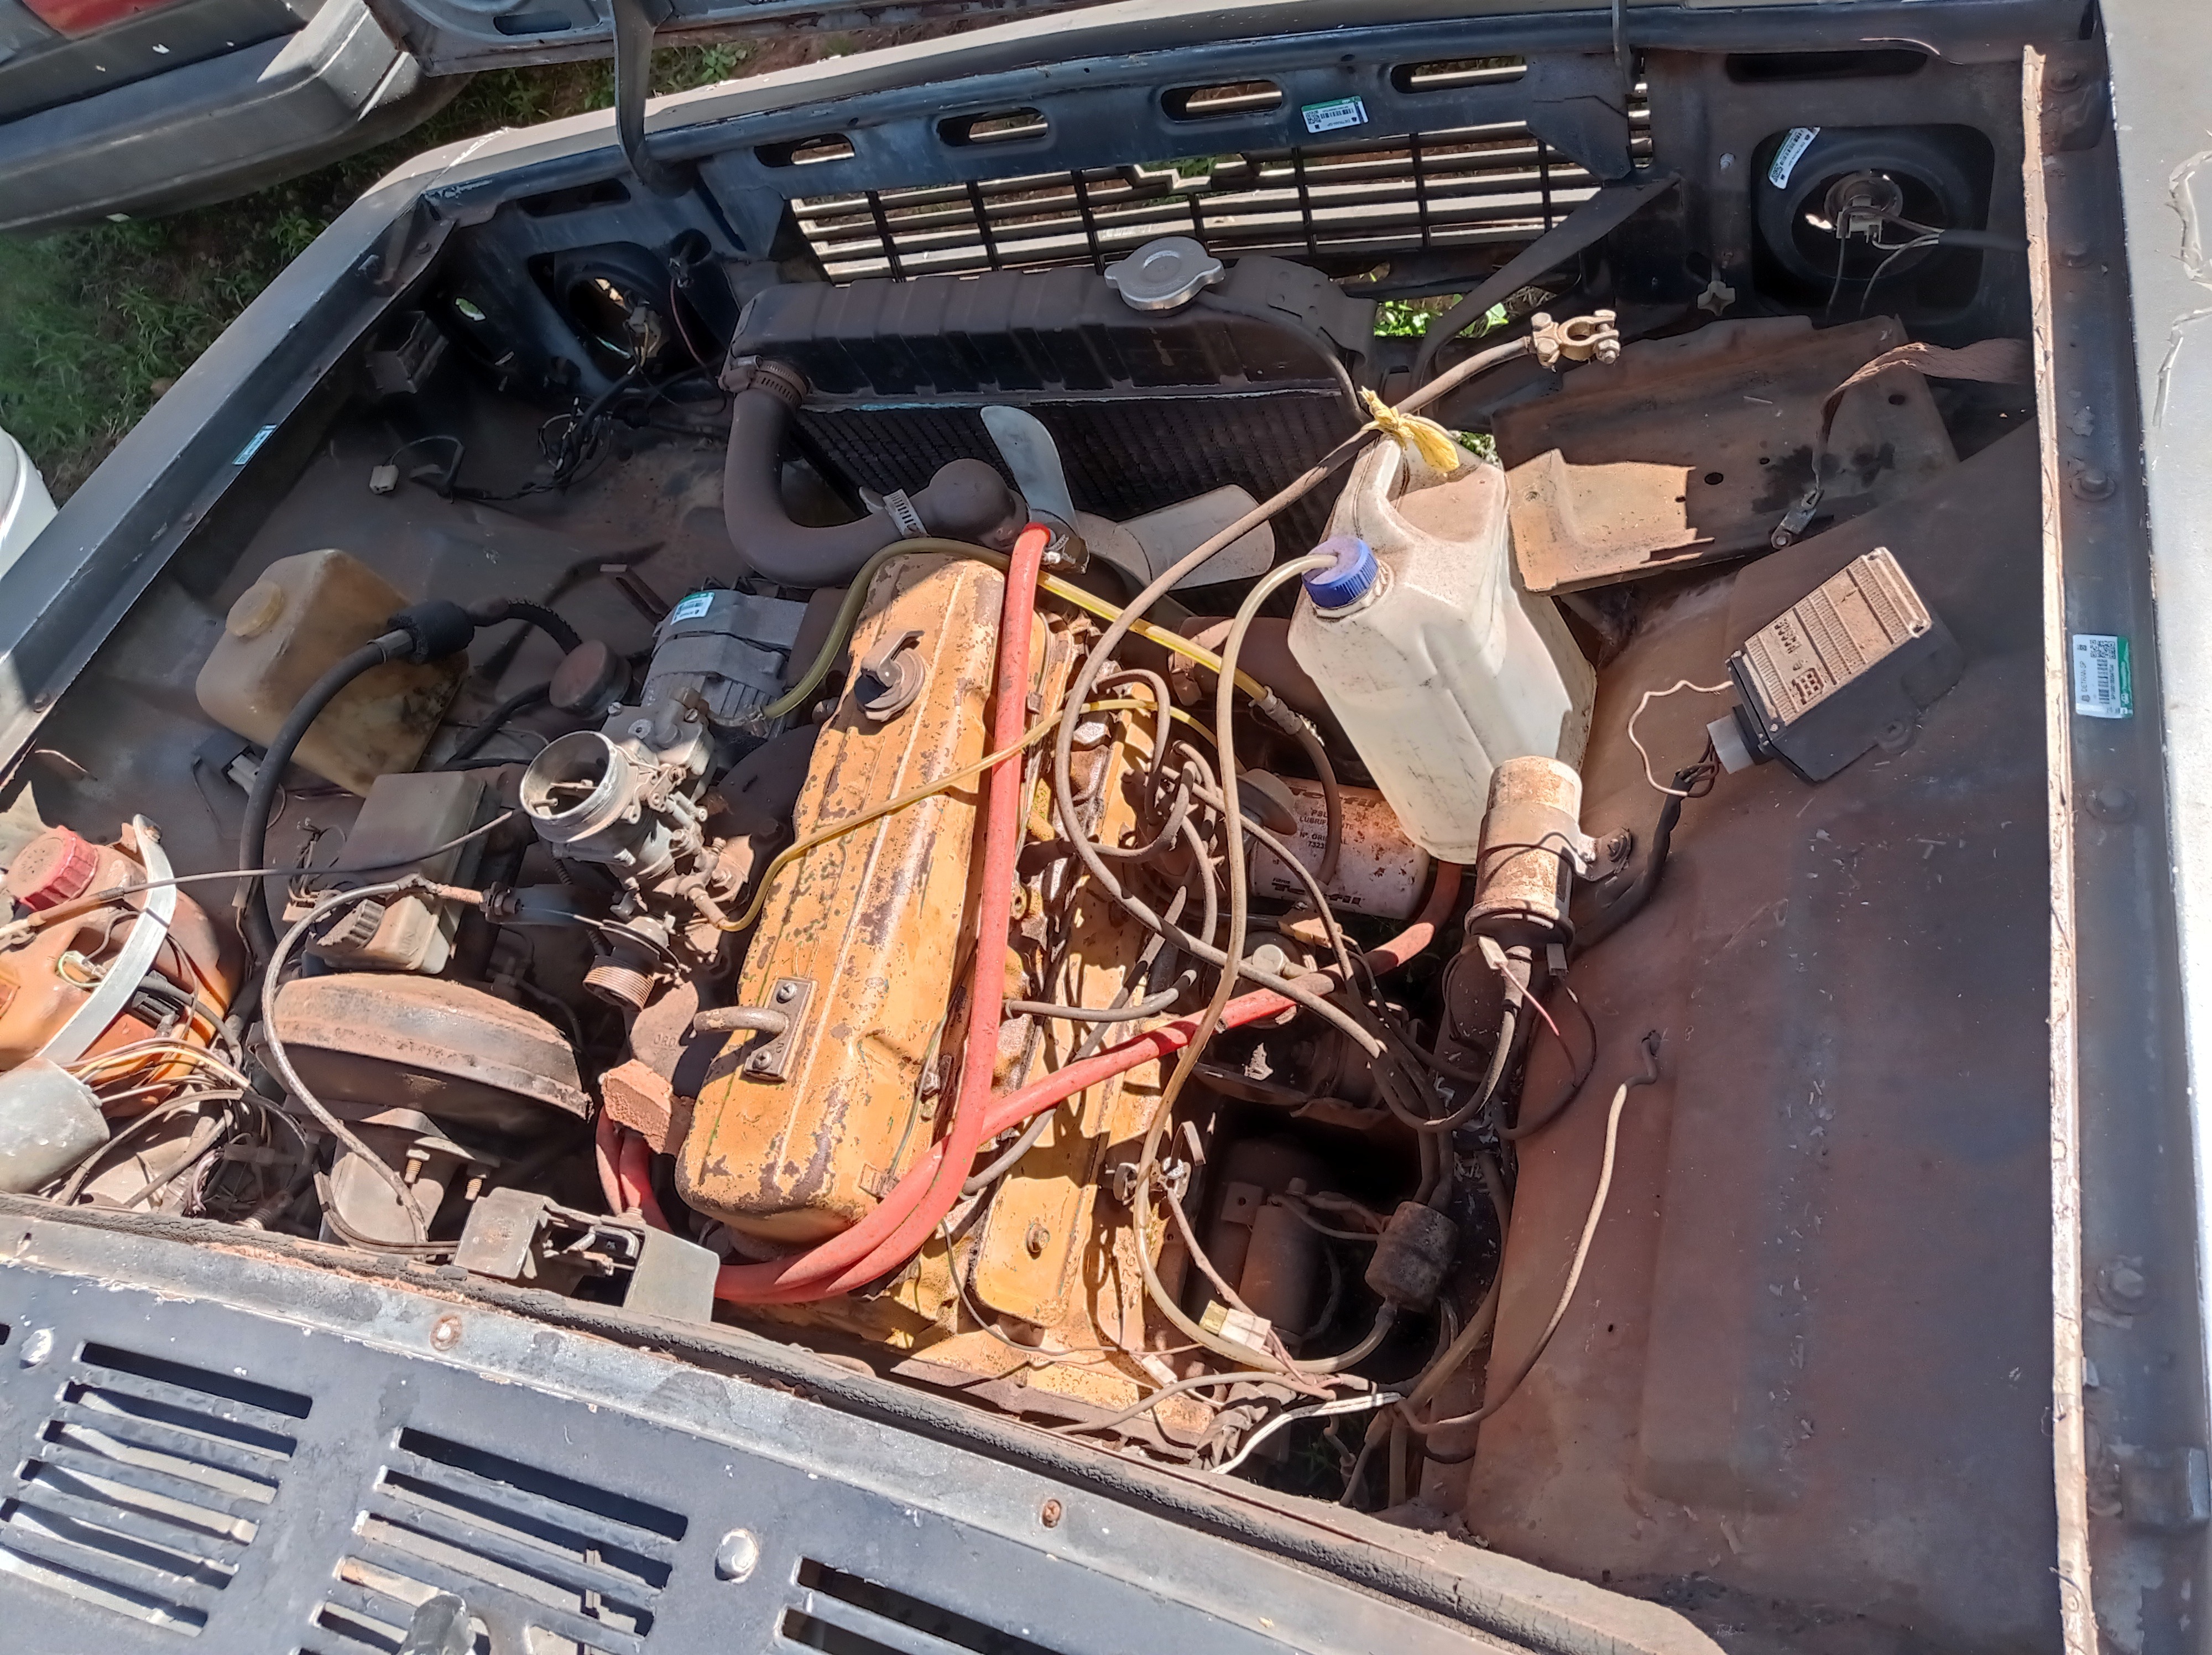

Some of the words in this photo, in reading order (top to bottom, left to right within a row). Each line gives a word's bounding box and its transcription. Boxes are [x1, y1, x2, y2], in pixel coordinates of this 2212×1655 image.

[1774, 617, 1802, 654] BOSCH
[1289, 787, 1380, 808] Tefil
[1300, 816, 1354, 830] LUBRIFTE
[1308, 841, 1326, 849] 7323
[1312, 834, 1348, 845] ORIL
[1272, 882, 1361, 906] Tefil
